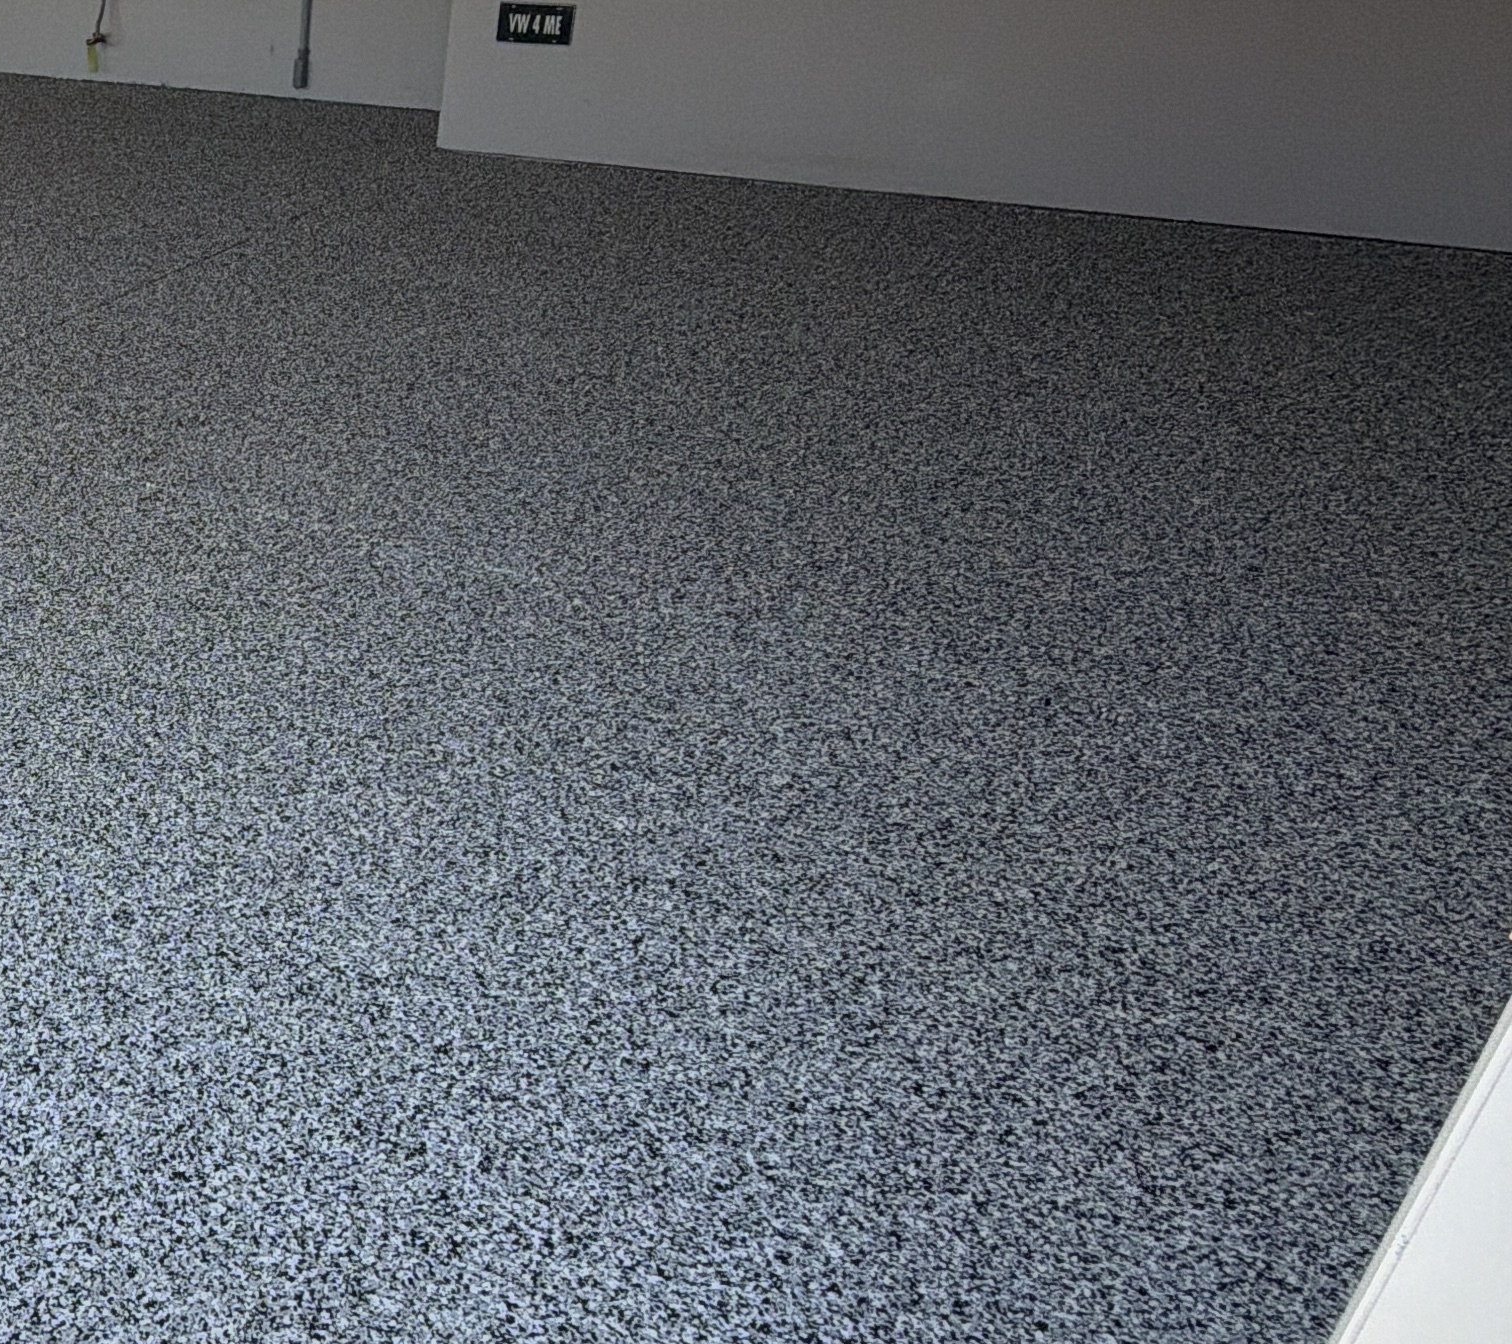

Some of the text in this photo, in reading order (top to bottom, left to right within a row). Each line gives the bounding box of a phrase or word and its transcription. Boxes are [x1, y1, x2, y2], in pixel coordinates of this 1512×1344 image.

[508, 12, 563, 36] VW 4 ME
